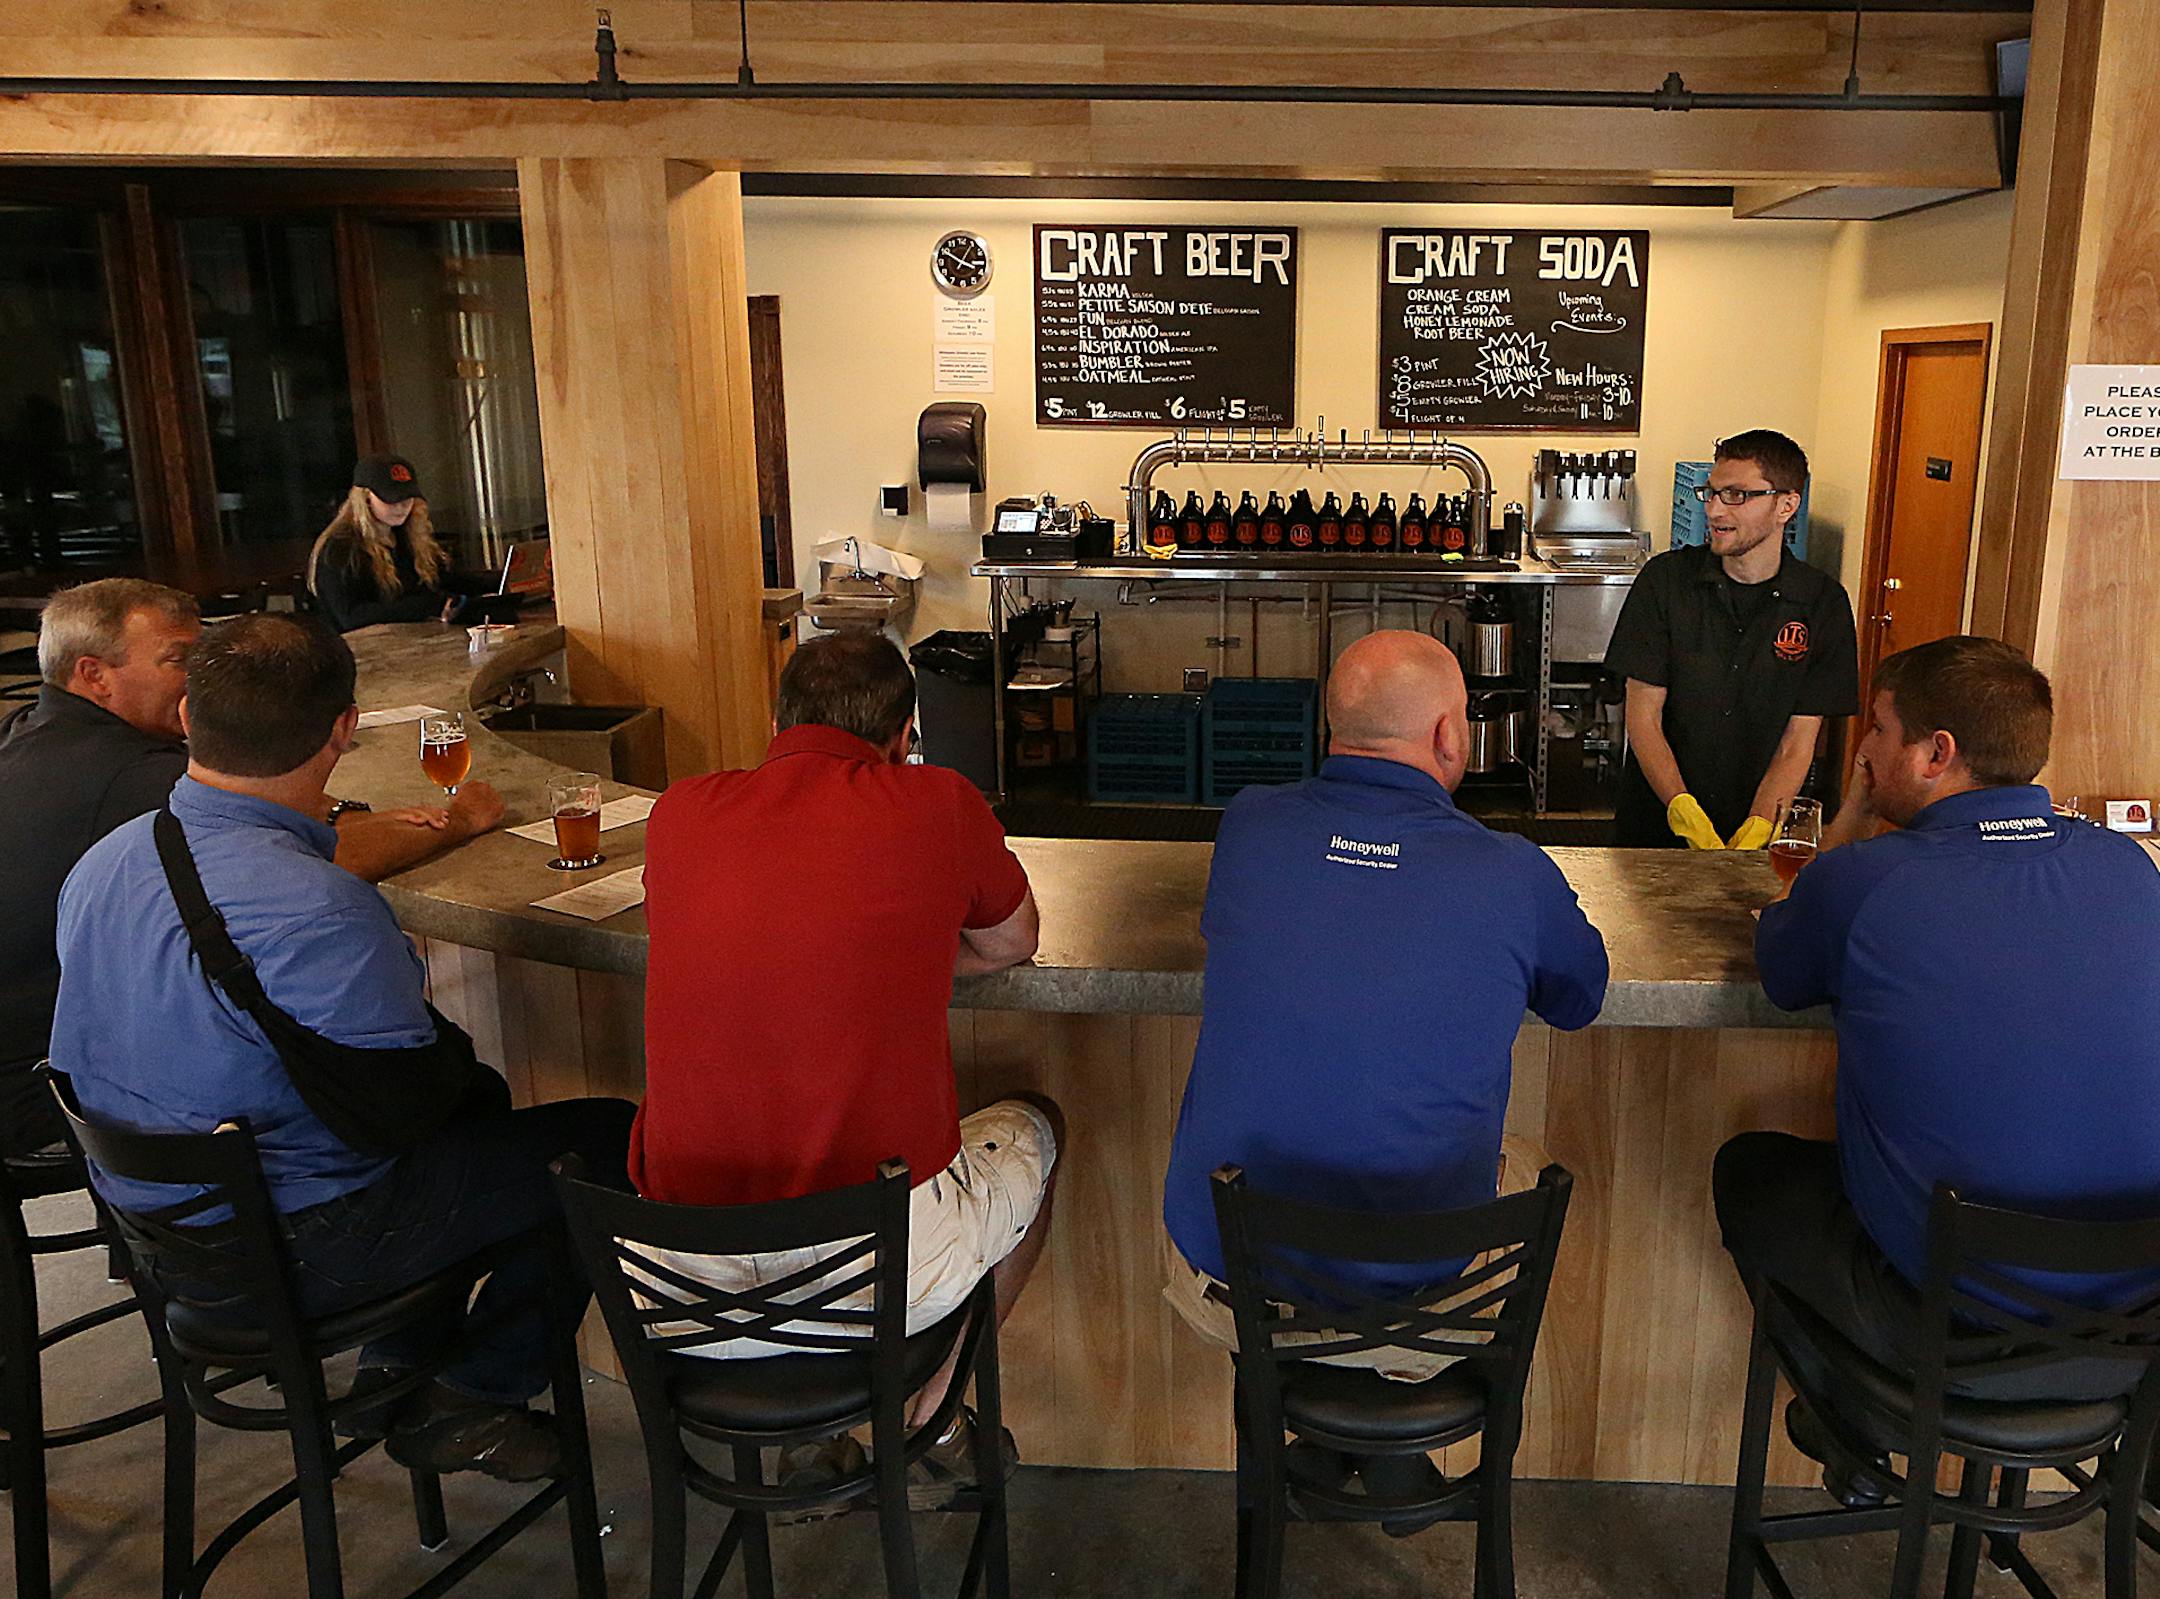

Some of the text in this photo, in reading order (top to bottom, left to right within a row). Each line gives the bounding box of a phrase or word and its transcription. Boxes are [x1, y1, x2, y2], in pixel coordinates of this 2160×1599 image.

[1041, 231, 1290, 285] CRAFT BEER
[1388, 236, 1639, 287] CRAFT SODA
[1078, 282, 1130, 299] KARMA
[1407, 288, 1511, 303] ORANGE CREAM
[1078, 299, 1125, 312] PETITE
[1128, 299, 1175, 315] SAISON
[1405, 304, 1500, 315] CREAM SODA
[1078, 312, 1106, 325] FUN
[1403, 315, 1515, 328] HONEY LEMONADE
[1079, 326, 1097, 339] EL
[1102, 325, 1159, 339] DORADO
[1414, 328, 1485, 340] ROOT BEER
[1079, 339, 1170, 354] INSPIRATION
[1079, 355, 1144, 369] BUMBLER
[1491, 345, 1530, 367] NOW
[1392, 356, 1439, 373] $3 PINT
[1078, 369, 1151, 384] OATMEAL
[1490, 364, 1539, 385] HIRING
[1391, 374, 1411, 393] $8
[1457, 378, 1479, 387] FILL
[1389, 391, 1482, 407] $5 EMPTY GROWLER
[1388, 406, 1409, 423] $4
[1411, 414, 1441, 423] FLIGHT
[2084, 406, 2142, 417] PLACE
[2083, 446, 2106, 457] AT
[2111, 447, 2144, 457] THE
[1330, 835, 1399, 857] Honeywell
